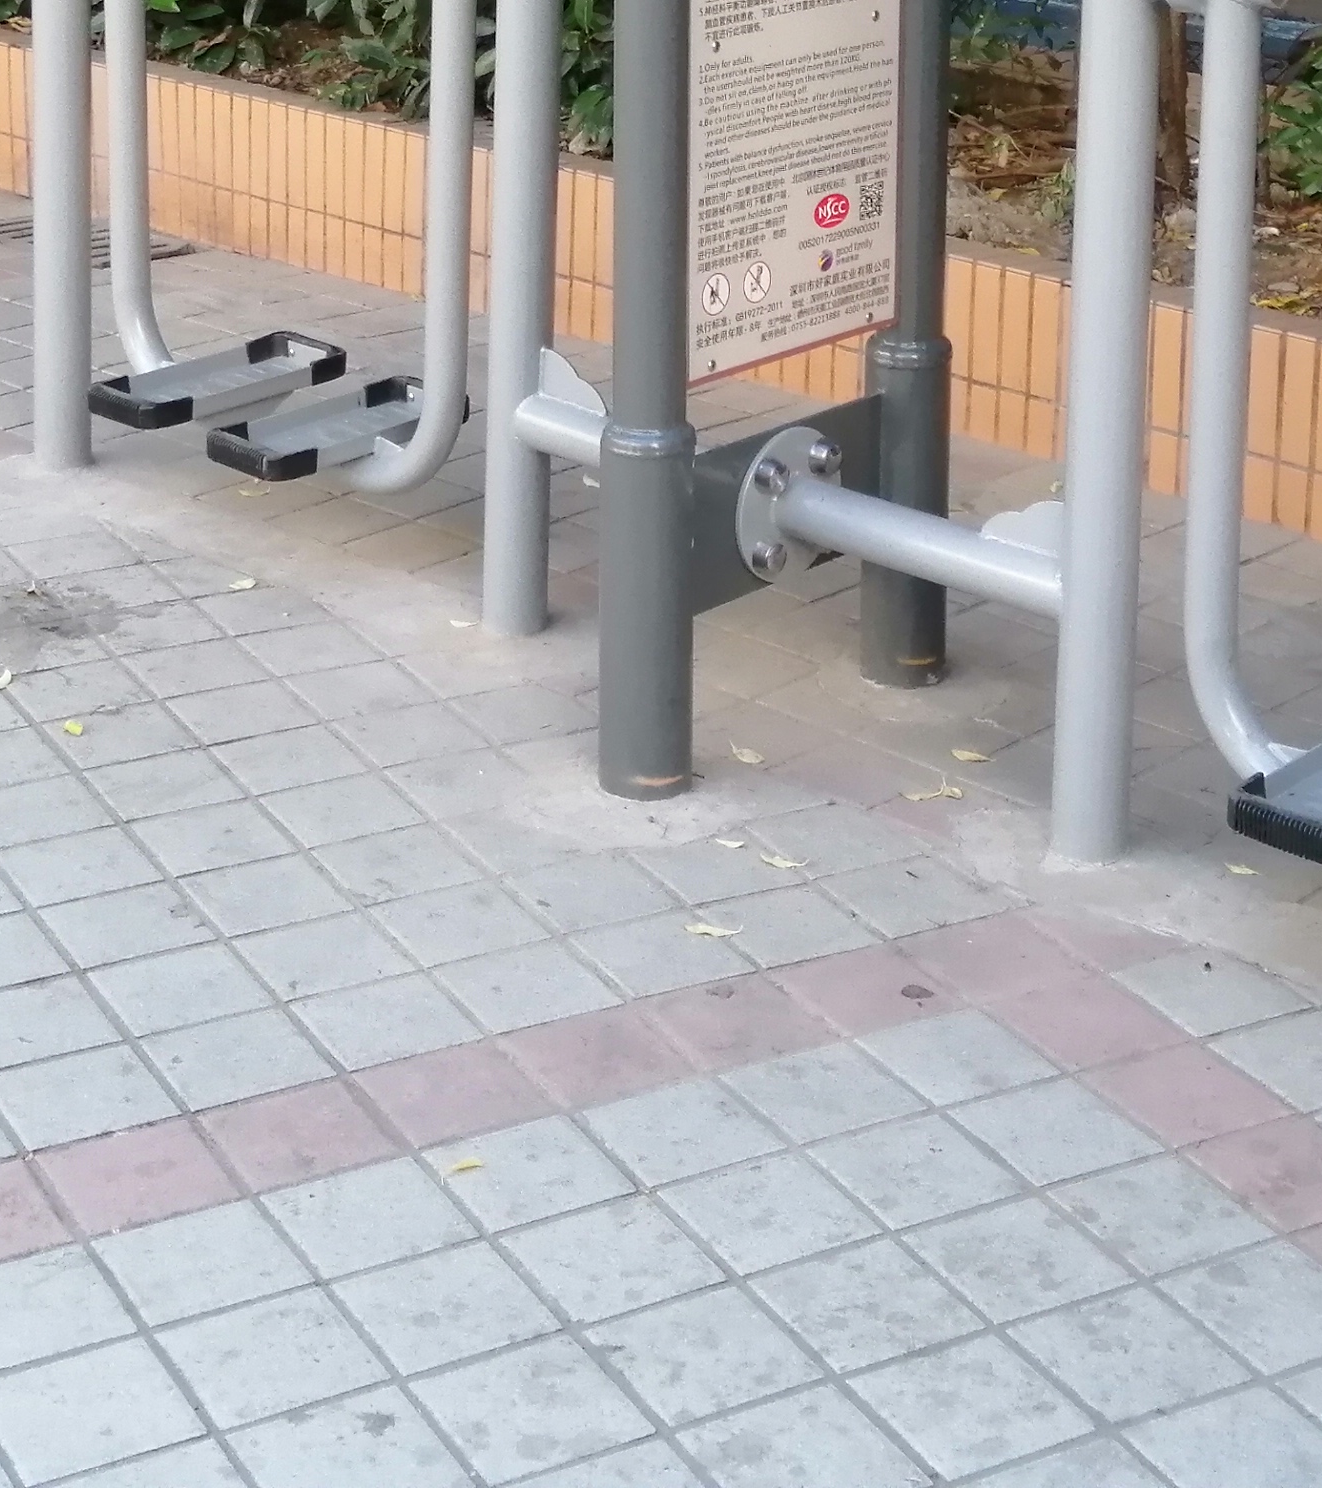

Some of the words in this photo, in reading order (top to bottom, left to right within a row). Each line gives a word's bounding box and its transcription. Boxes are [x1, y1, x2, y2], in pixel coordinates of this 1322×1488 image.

[721, 59, 730, 68] for
[785, 57, 796, 66] can
[813, 52, 821, 60] be
[838, 46, 847, 55] for
[704, 84, 715, 94] the
[766, 72, 774, 80] be
[806, 61, 822, 72] more
[824, 58, 838, 68] than
[715, 93, 726, 102] not
[795, 76, 804, 85] on
[805, 74, 815, 83] the
[751, 95, 765, 105] case
[767, 93, 773, 102] of
[746, 106, 765, 119] using
[767, 103, 778, 113] the
